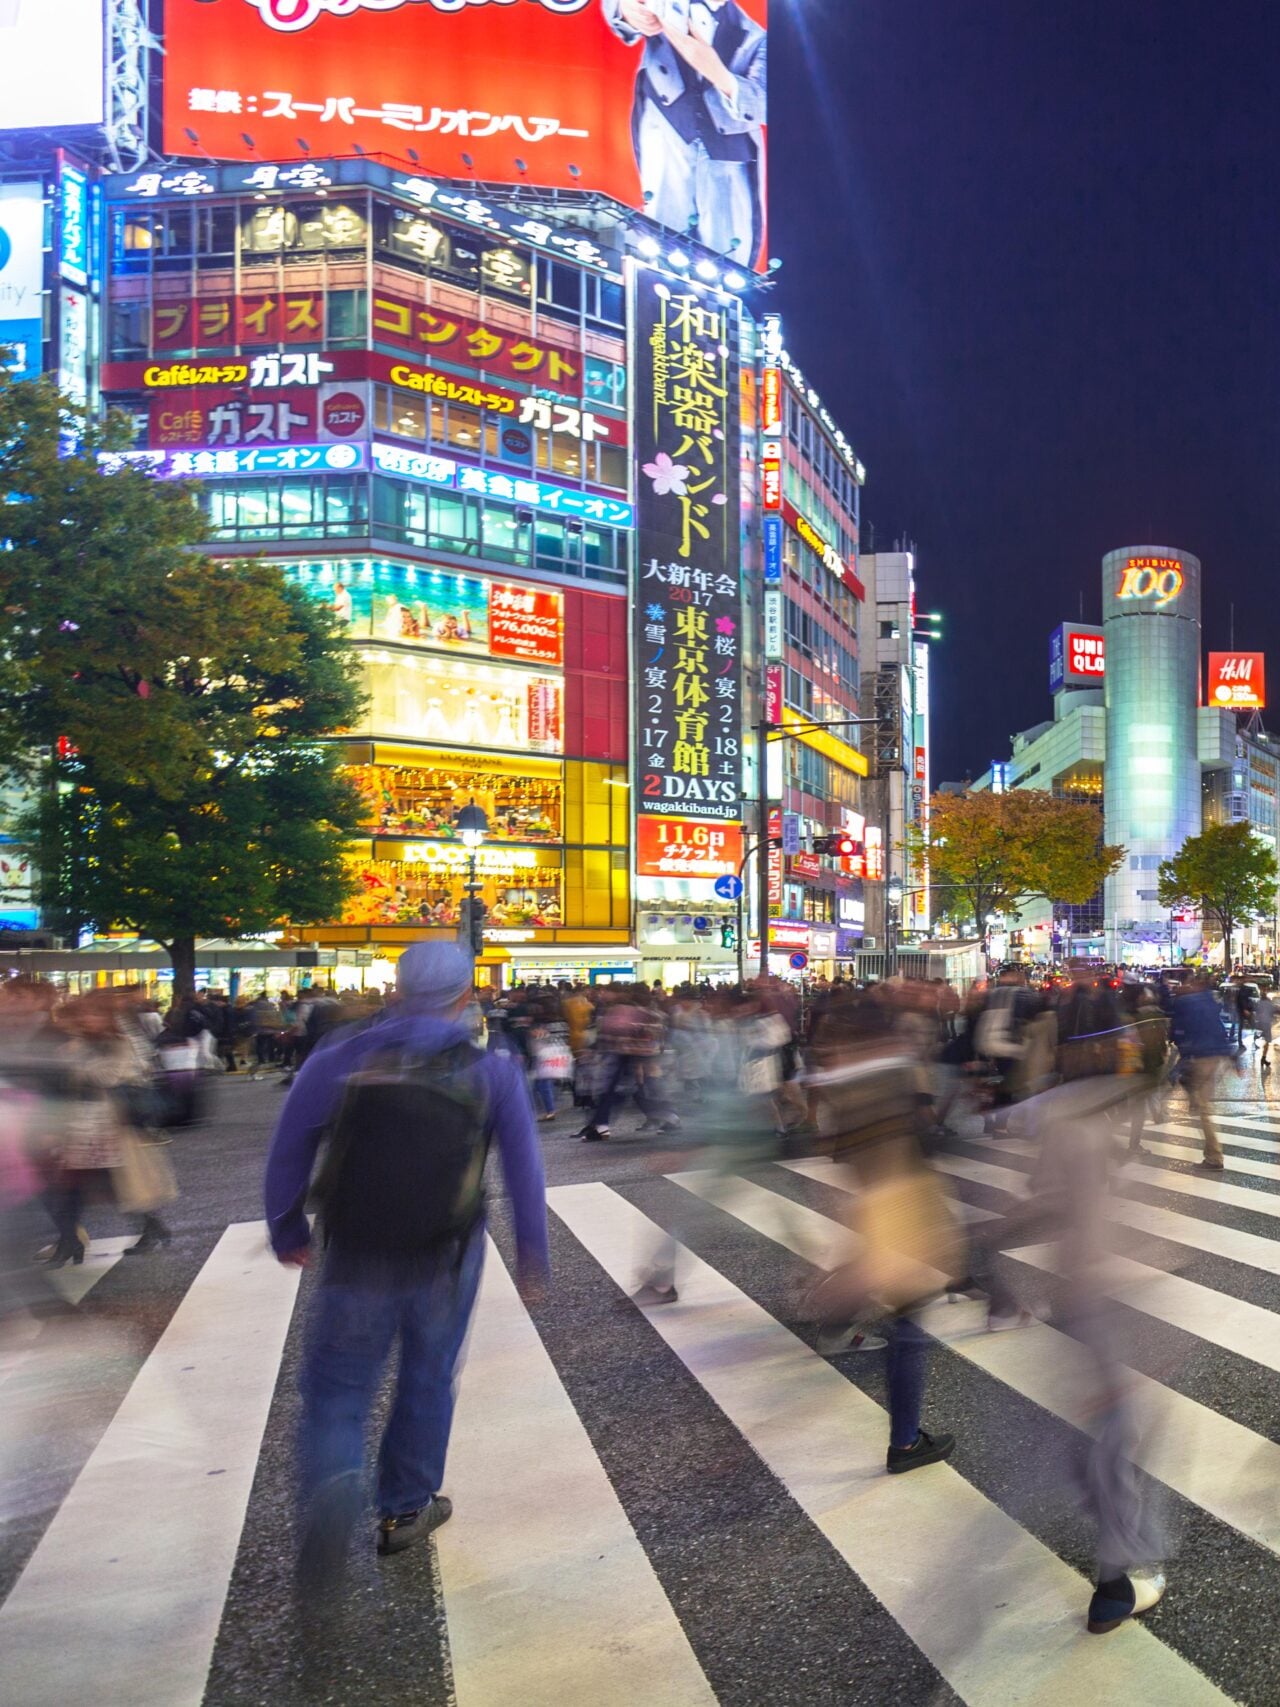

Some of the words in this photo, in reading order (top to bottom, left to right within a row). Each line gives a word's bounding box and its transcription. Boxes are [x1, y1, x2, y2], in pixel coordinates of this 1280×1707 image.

[155, 303, 320, 338] プライス
[374, 299, 577, 381] コンタクト
[250, 353, 334, 388] ガスト
[207, 402, 309, 445] ガスト
[327, 412, 362, 425] ガスト
[518, 397, 608, 440] ガスト
[669, 294, 728, 558] 和楽器バンド
[170, 448, 321, 474] 英会話イーオン
[460, 466, 630, 521] 英会話イーオン
[642, 558, 737, 597] 大新年会
[1129, 559, 1182, 569] SHIBUYA
[669, 587, 714, 606] 2017
[1116, 566, 1184, 608] 109
[1073, 638, 1103, 654] UNI
[1220, 659, 1253, 681] H&M
[672, 605, 711, 777] 東京体育館
[643, 801, 738, 817] wagakkiband.jp
[664, 844, 719, 860] チケット
